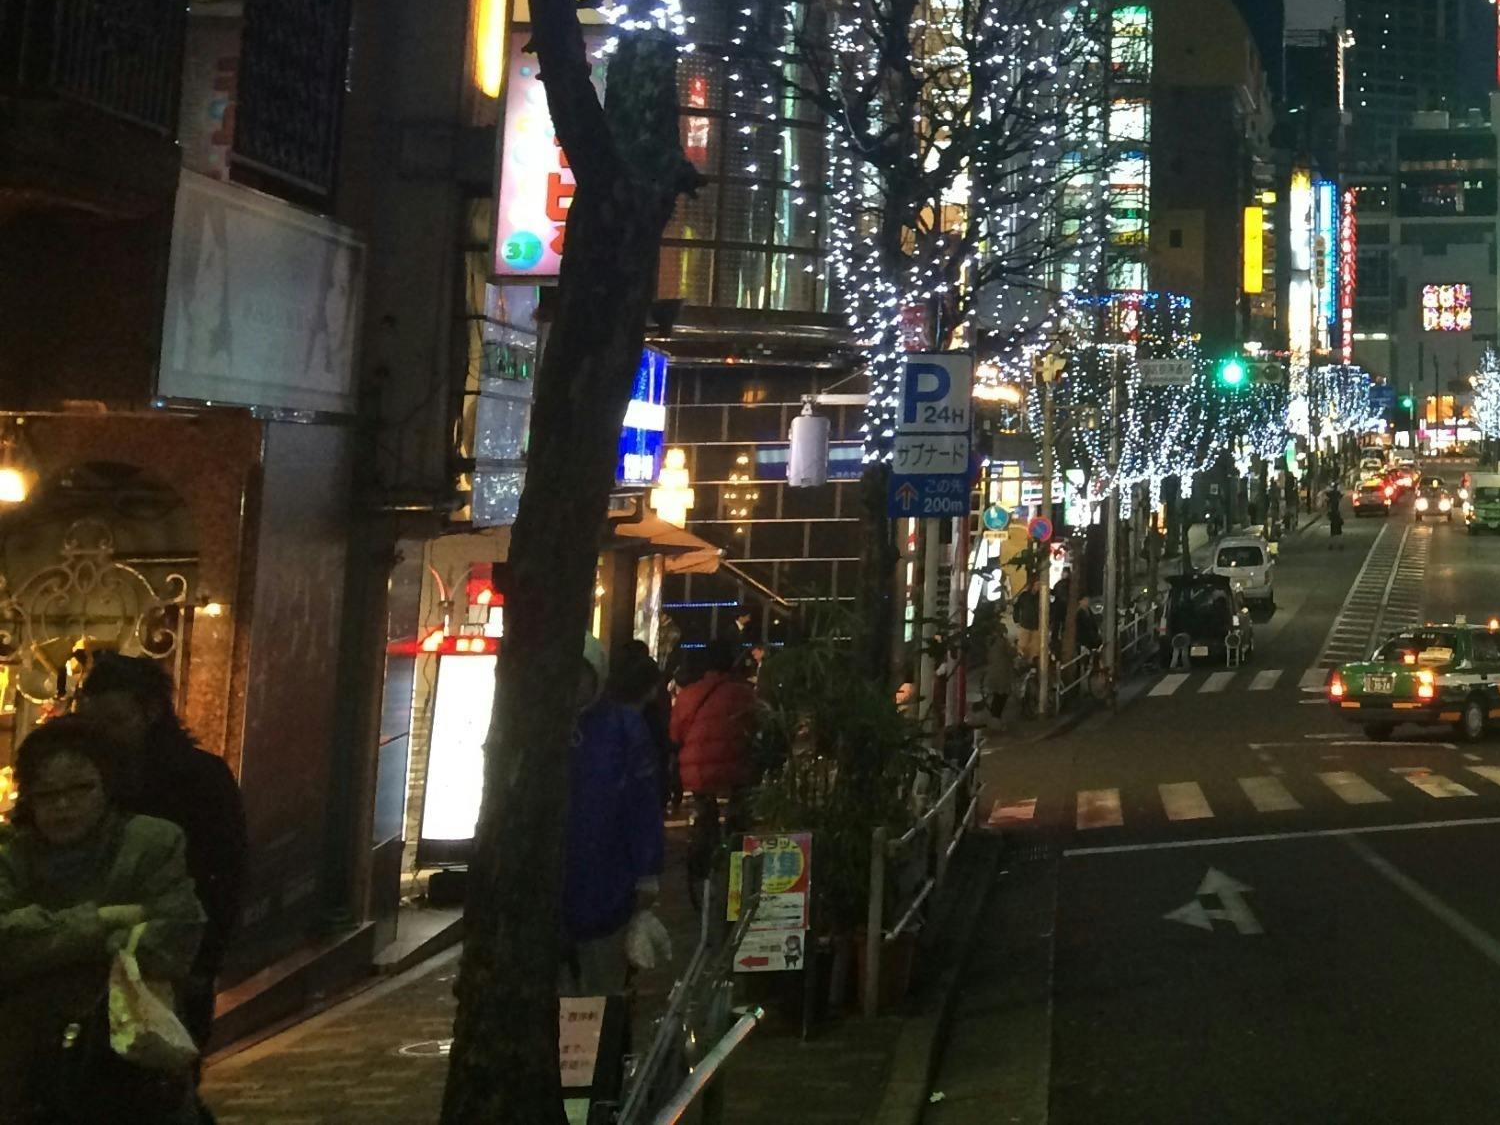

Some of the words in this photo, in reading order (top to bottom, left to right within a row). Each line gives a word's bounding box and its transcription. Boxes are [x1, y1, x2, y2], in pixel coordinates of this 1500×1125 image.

[903, 362, 950, 424] P
[924, 405, 964, 424] 24H
[924, 497, 964, 513] 200m
